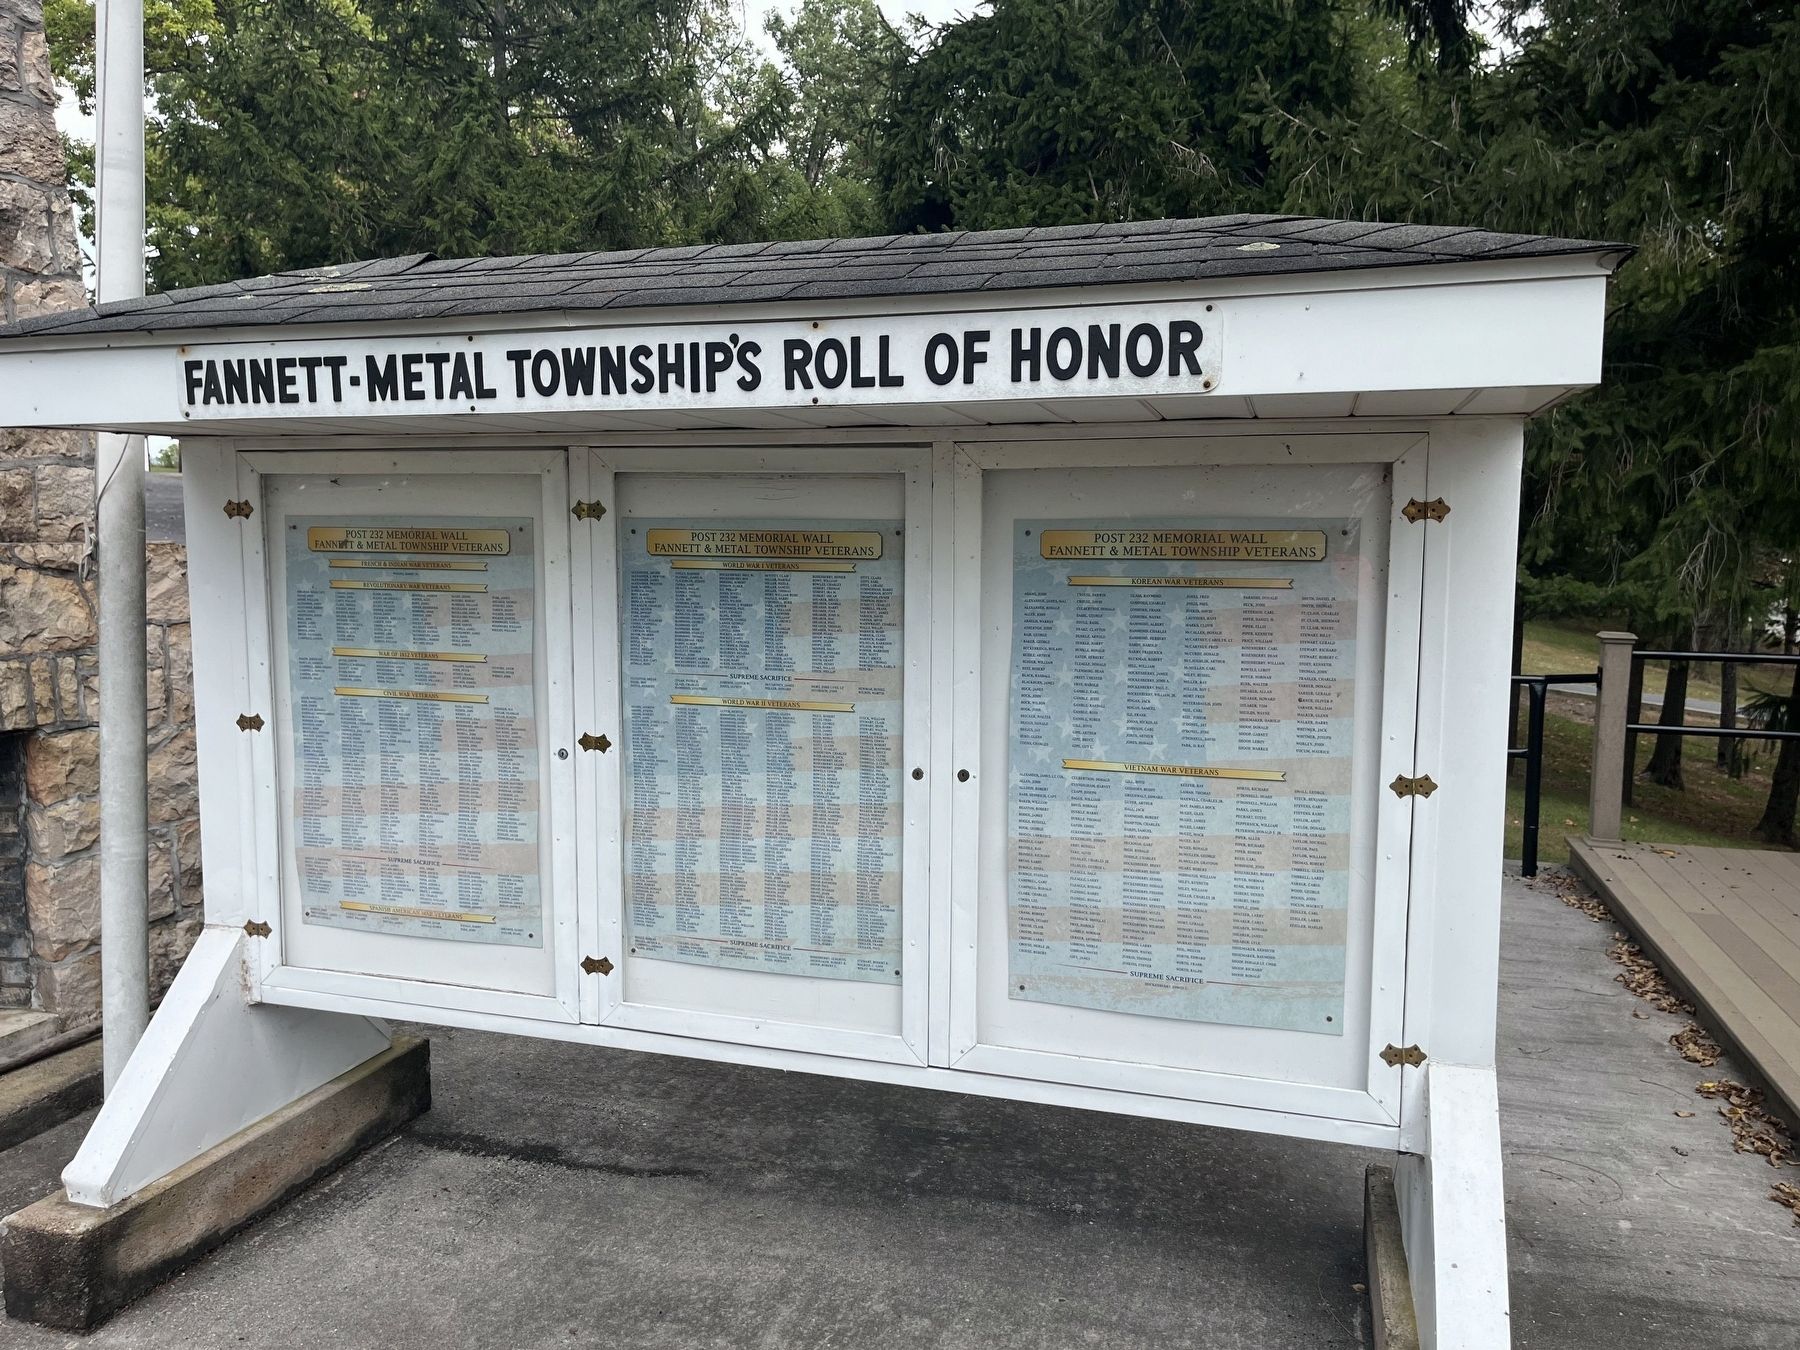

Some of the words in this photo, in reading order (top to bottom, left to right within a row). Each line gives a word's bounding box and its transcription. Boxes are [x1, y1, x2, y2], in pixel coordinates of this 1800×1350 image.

[184, 351, 496, 405] FANNETT-METAL
[506, 333, 761, 398] TOWNSHIP'S
[783, 334, 904, 390] ROLL
[924, 330, 991, 385] OF
[1010, 320, 1203, 382] HONOR
[345, 530, 367, 538] POST
[370, 530, 384, 539] 232
[387, 530, 438, 540] MEMORIAL
[441, 531, 468, 540] WALL
[691, 532, 717, 541] POST
[720, 533, 735, 542] 232
[739, 533, 799, 543] MEMORIAL
[802, 534, 834, 544] WALL
[1094, 533, 1124, 543] POST
[1129, 533, 1149, 544] 232
[1153, 533, 1226, 544] MEMORIAL
[1231, 533, 1268, 544] WALL
[357, 541, 364, 549] &
[366, 540, 397, 550] METAL
[400, 541, 449, 550] TOWNSHIP
[452, 542, 503, 552] VETERANS
[654, 543, 701, 553] FANNETT
[704, 544, 712, 553] &
[715, 544, 751, 554] METAL
[755, 544, 811, 555] TOWNSHIP
[815, 546, 874, 556] VETERANS
[1050, 545, 1105, 556] FANNETT
[1109, 546, 1119, 556] &
[1122, 546, 1168, 556] METAL
[1172, 546, 1240, 557] TOWNSHIP
[1245, 546, 1316, 558] VETERANS
[1124, 764, 1158, 773] VIETNAM
[1160, 766, 1178, 774] WAR
[1179, 767, 1219, 776] VETERANS
[434, 910, 464, 919] VETERANS
[730, 940, 757, 948] SUPREME
[758, 941, 791, 951] SACRIFICE
[1130, 971, 1164, 982] SUPREME
[1165, 974, 1204, 985] SACRIFICE
